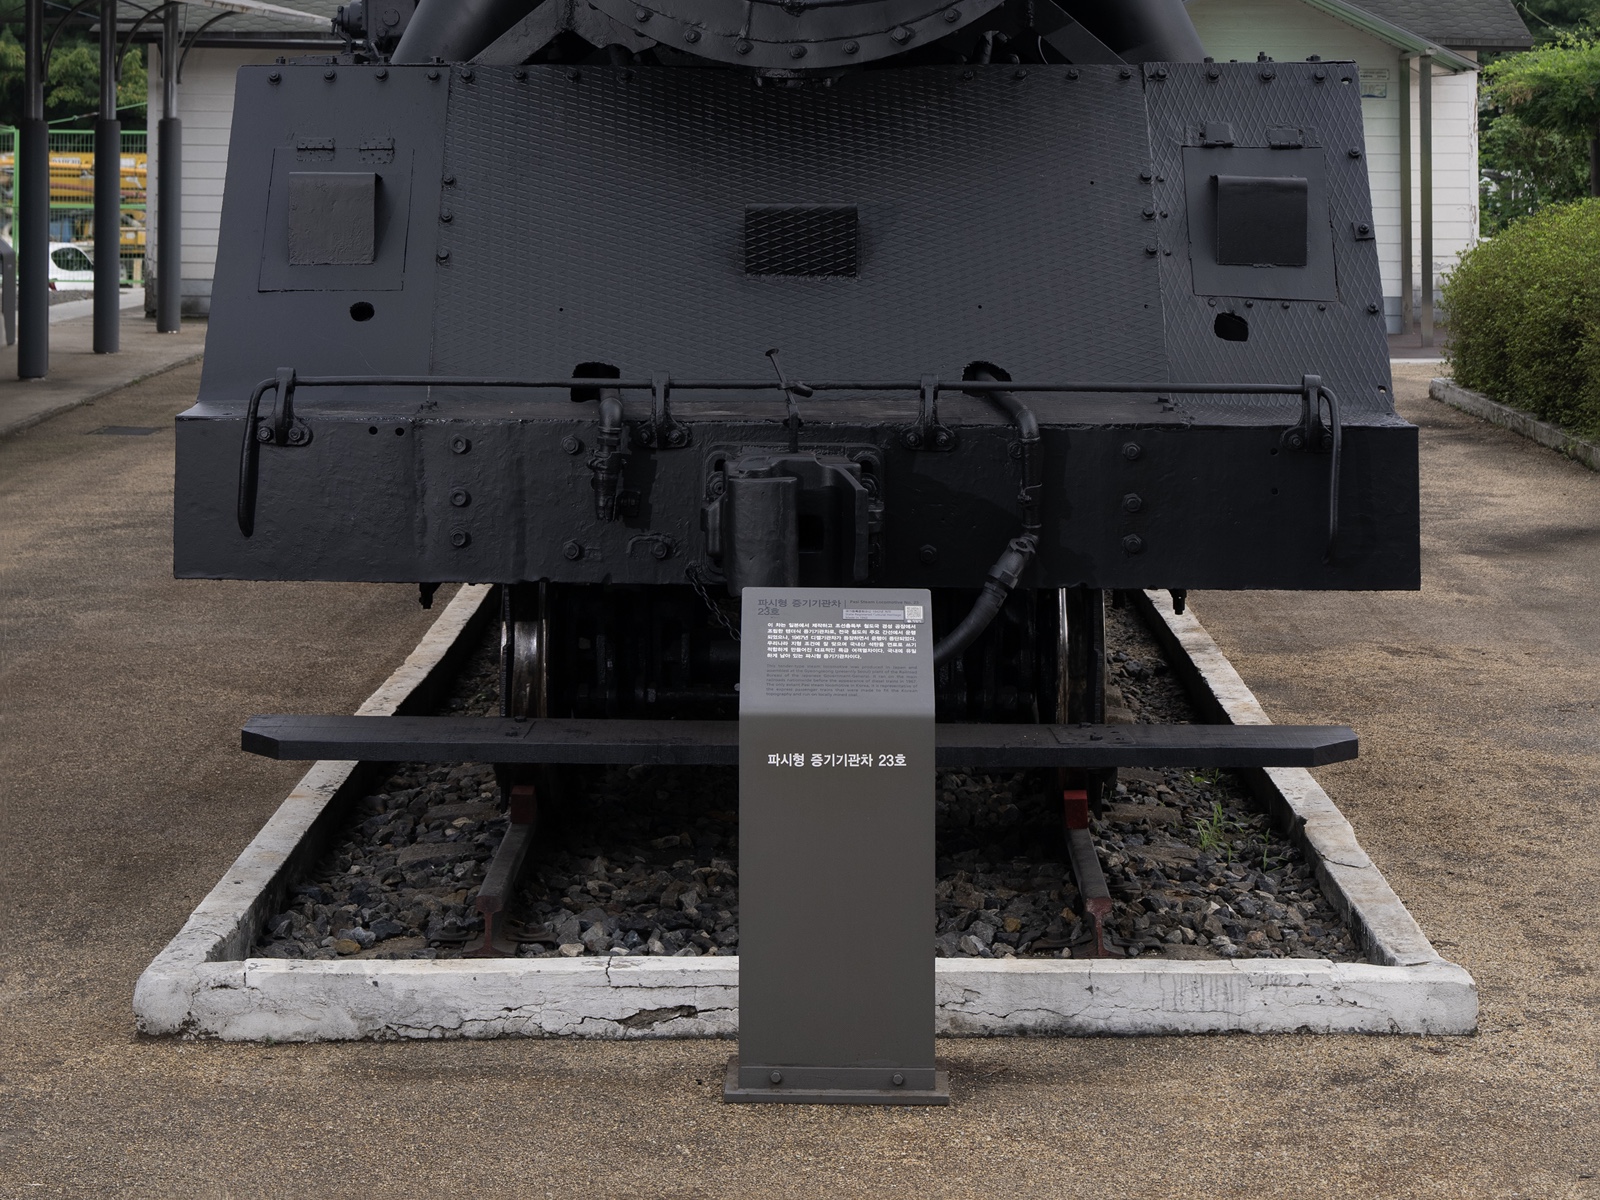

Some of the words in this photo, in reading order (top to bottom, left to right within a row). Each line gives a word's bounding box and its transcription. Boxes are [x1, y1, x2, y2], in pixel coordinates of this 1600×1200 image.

[758, 599, 787, 607] 파시형
[792, 599, 841, 607] 증기기관차
[768, 754, 804, 767] 파시형
[811, 754, 873, 767] 증기기관차
[879, 754, 906, 767] 23호
